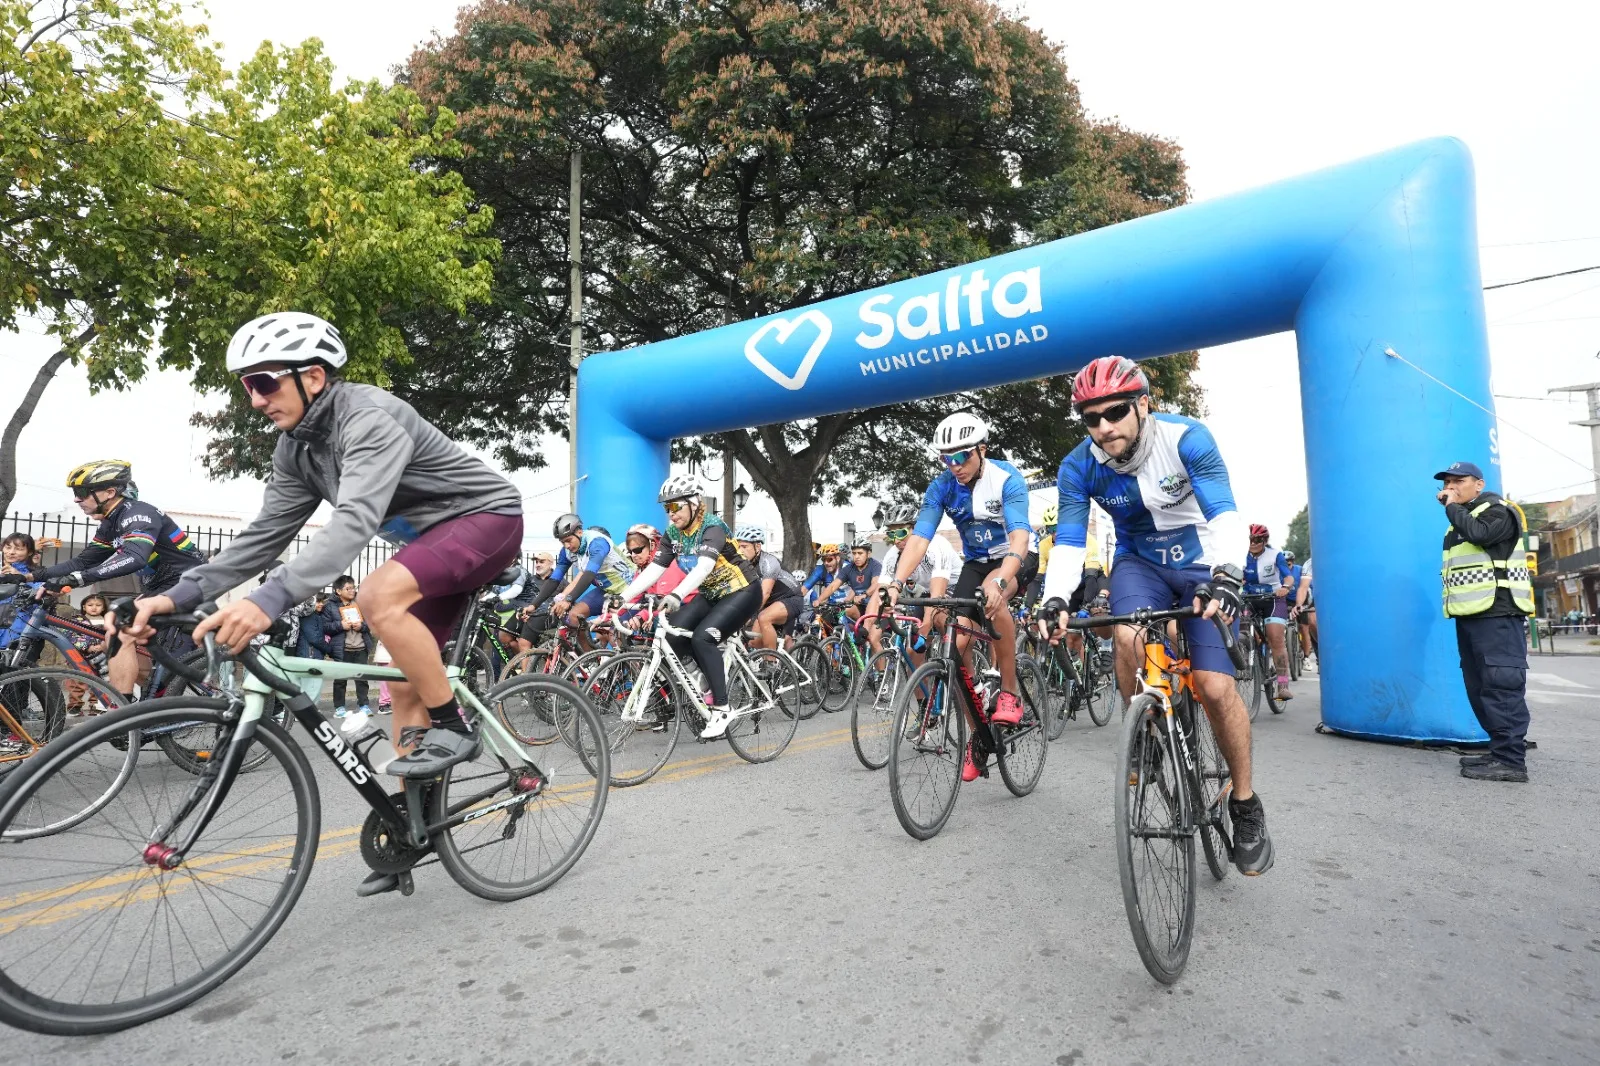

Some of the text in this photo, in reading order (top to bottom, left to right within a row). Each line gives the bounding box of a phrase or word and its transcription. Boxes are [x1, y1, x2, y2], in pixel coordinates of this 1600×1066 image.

[855, 266, 1043, 349] Salta
[860, 324, 1049, 376] MUNICIPALIDAD
[974, 528, 993, 543] 54
[1155, 544, 1185, 565] 78
[669, 652, 703, 704] MERIDA
[960, 666, 988, 724] MERIDA
[314, 720, 371, 785] SARS
